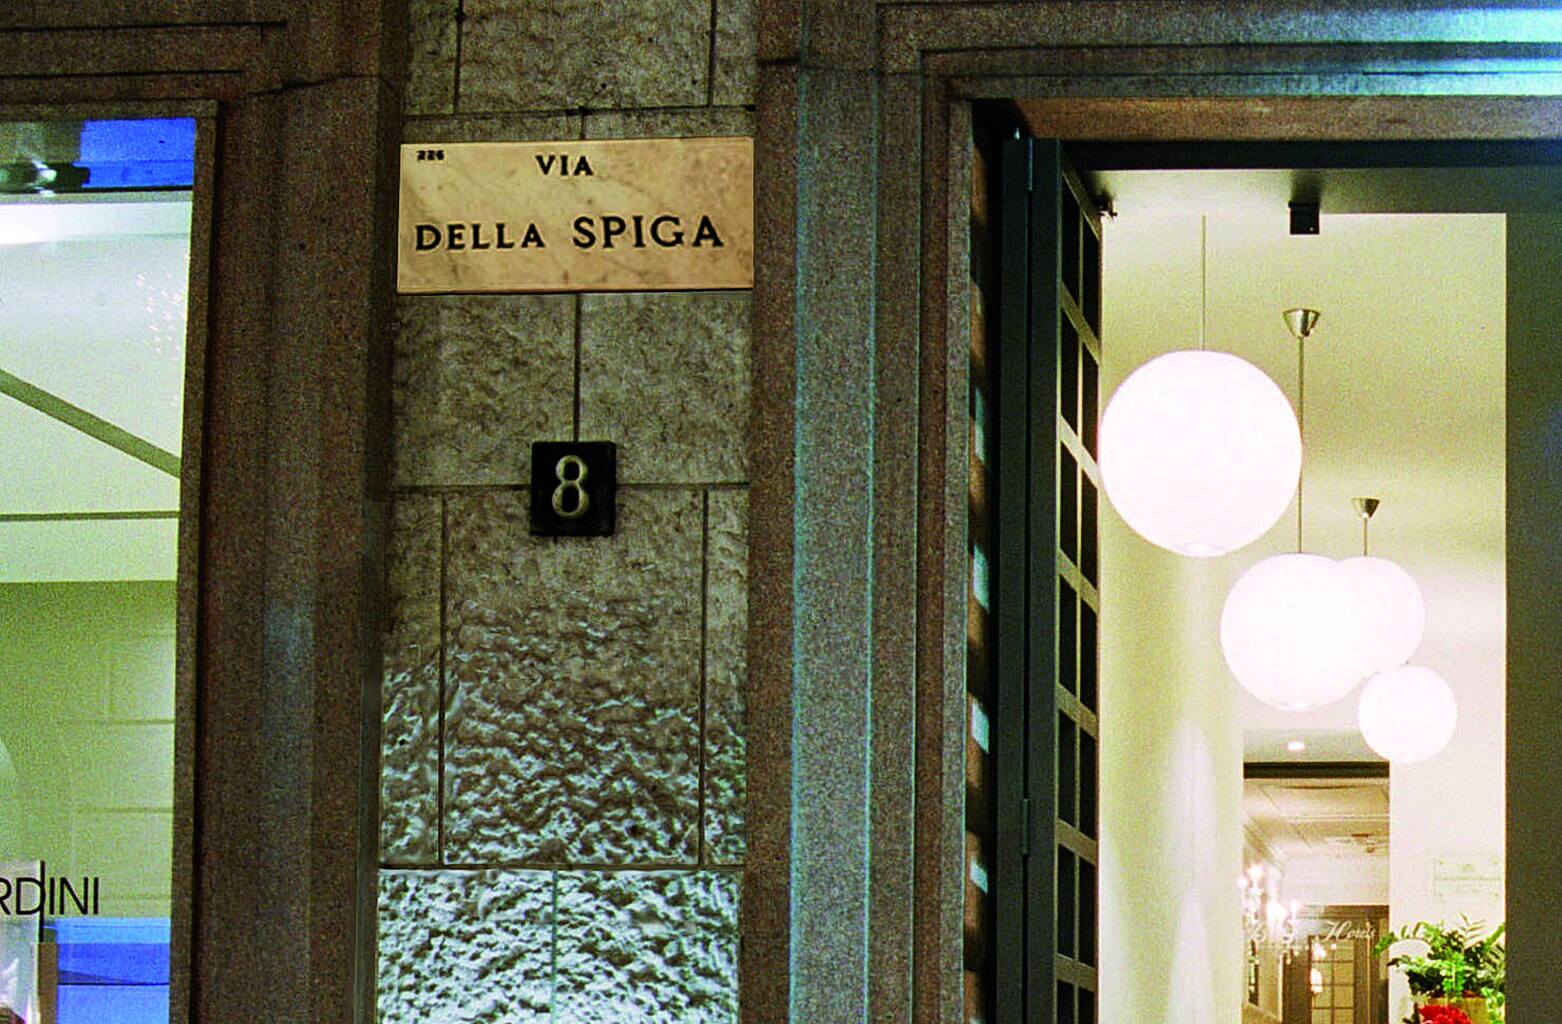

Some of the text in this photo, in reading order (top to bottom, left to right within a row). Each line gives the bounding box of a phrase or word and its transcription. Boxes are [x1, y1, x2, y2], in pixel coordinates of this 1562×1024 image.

[536, 155, 594, 176] VIA
[415, 215, 724, 252] DELLA SPIGA
[552, 455, 589, 517] 8
